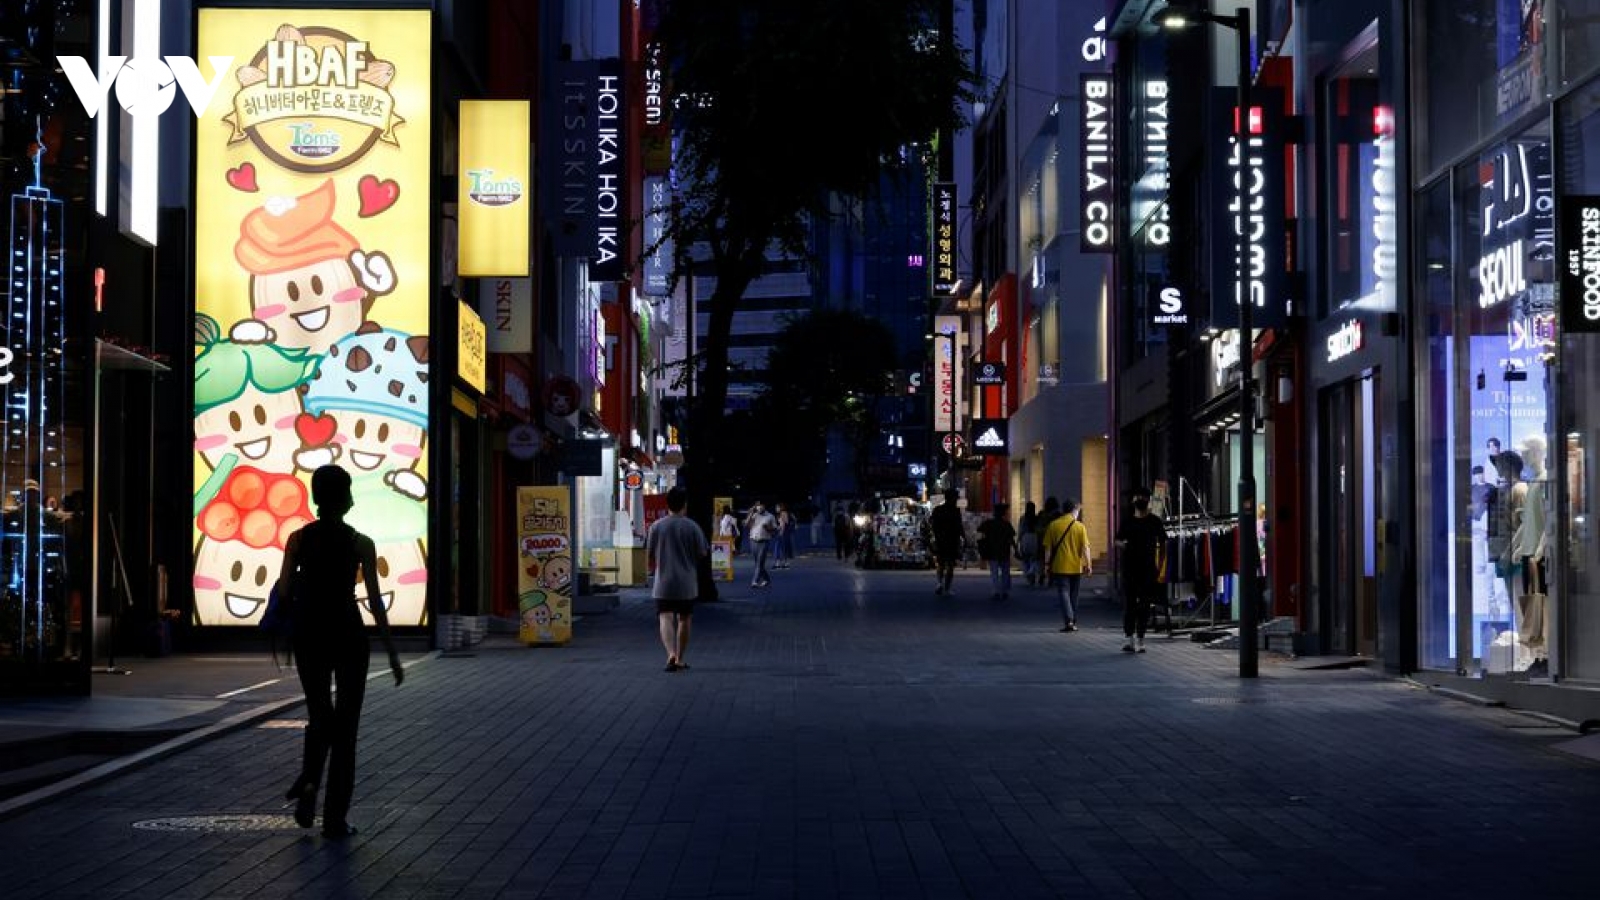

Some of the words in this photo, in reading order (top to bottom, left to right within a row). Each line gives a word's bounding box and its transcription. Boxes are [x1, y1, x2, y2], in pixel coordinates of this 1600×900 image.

[266, 40, 370, 90] HBAF
[1086, 80, 1108, 191] BANILA
[1086, 200, 1109, 245] CO
[1479, 239, 1526, 308] SEOUL
[1581, 207, 1600, 320] SKINFOOD
[496, 280, 511, 332] SKIN
[1159, 287, 1182, 314] S
